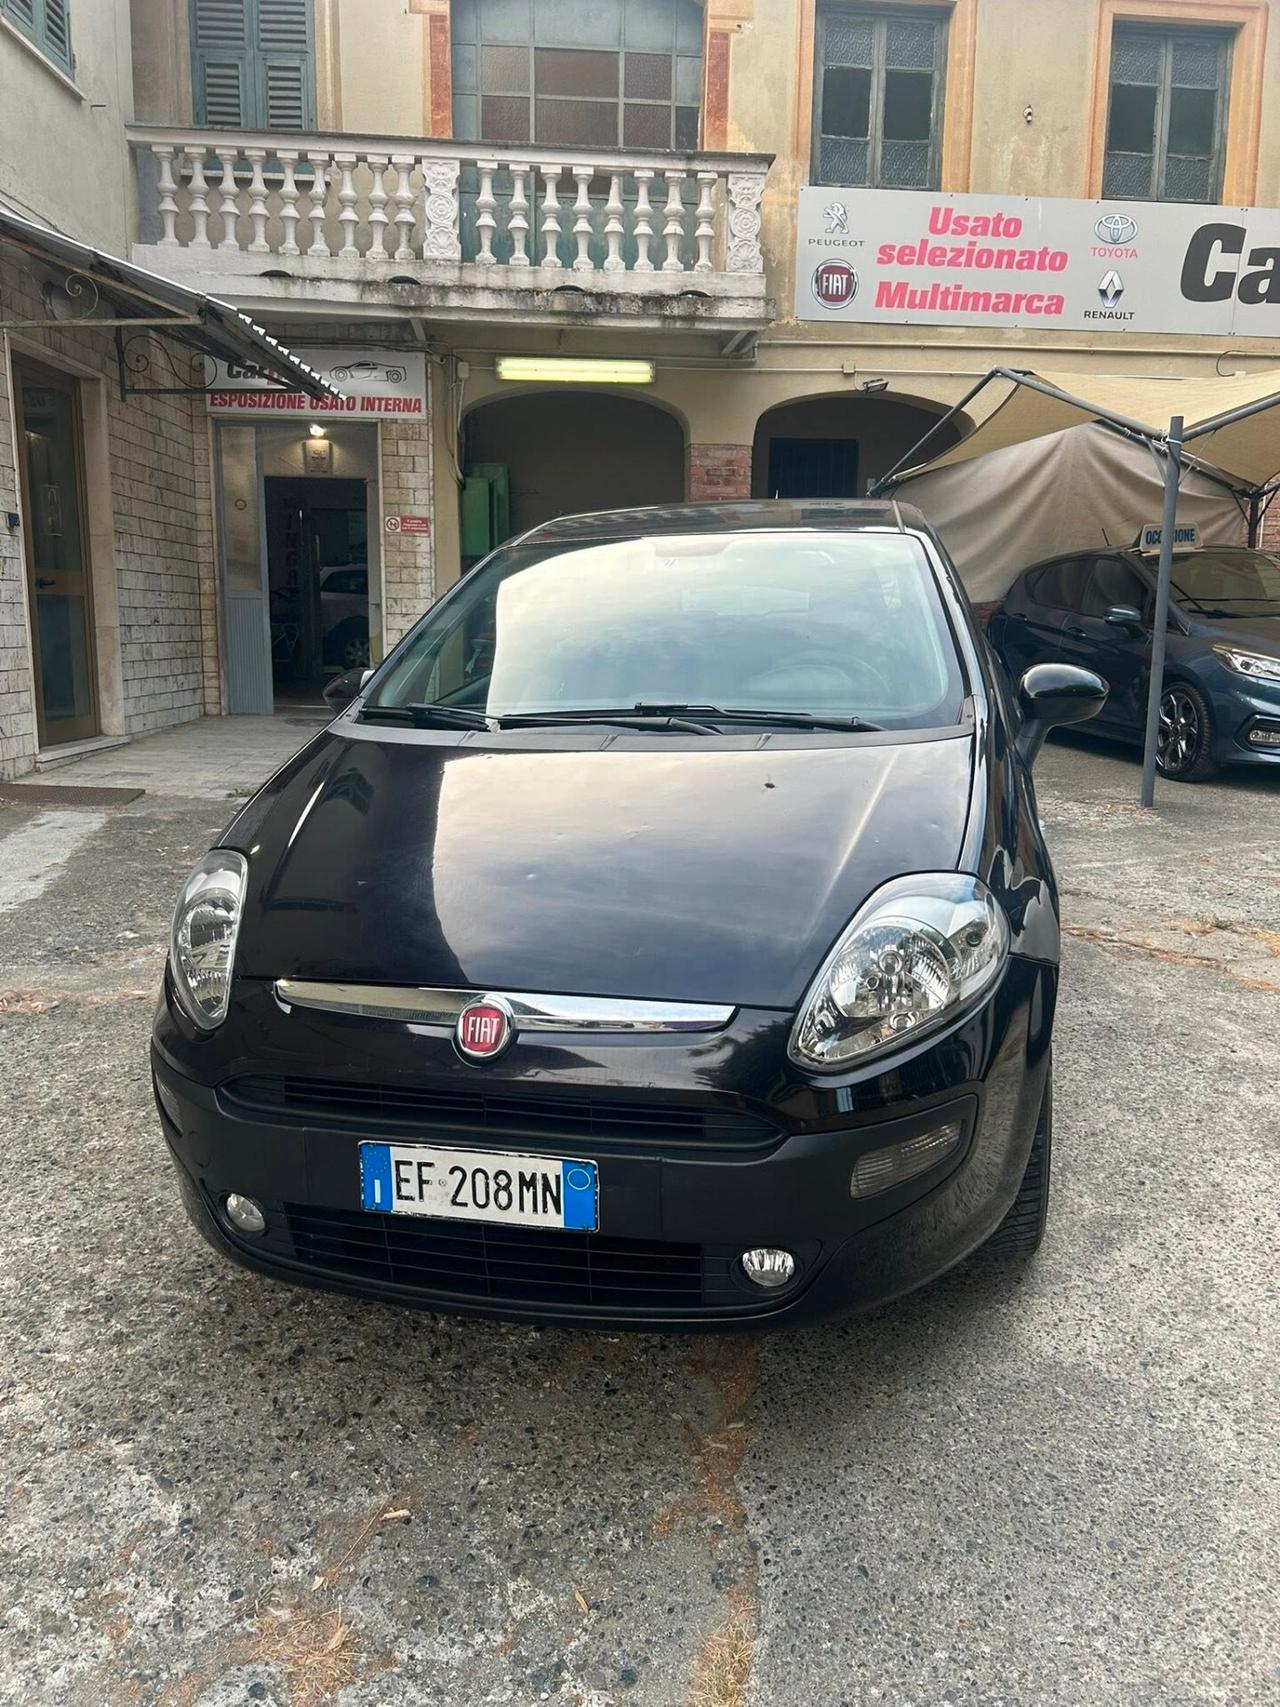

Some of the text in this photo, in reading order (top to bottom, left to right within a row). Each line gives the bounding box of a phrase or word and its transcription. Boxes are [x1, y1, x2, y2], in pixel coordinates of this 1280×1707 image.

[928, 207, 1022, 238] Usato
[808, 238, 865, 248] PEUGEOT
[1090, 247, 1138, 259] TOYOTA
[877, 240, 1068, 272] selezionato
[822, 273, 849, 297] FIAT
[874, 281, 1065, 315] Multimarca
[1084, 310, 1135, 320] RENAULT
[210, 393, 305, 410] ESPOSIZIONE
[360, 396, 422, 413] INTERNA
[1145, 528, 1195, 545] OCCIONE
[467, 1016, 501, 1044] FIAT
